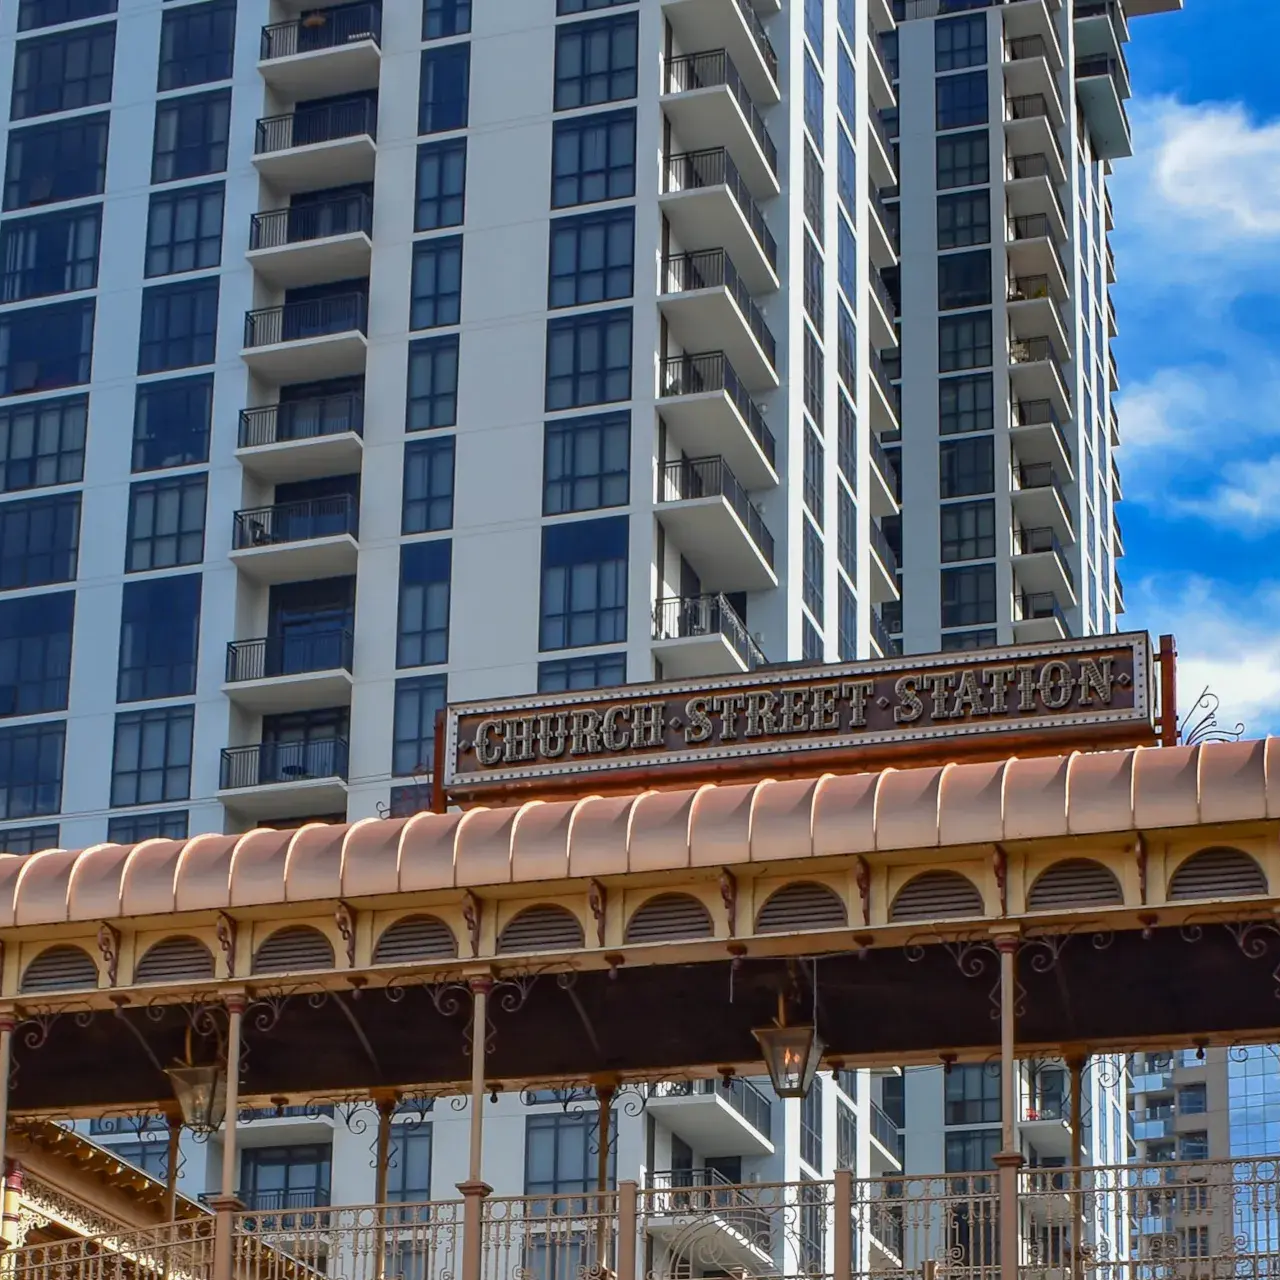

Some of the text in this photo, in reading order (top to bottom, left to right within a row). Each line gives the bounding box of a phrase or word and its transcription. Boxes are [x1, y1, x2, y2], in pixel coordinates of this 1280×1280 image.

[472, 655, 1114, 765] CHURCH STREET STATION
